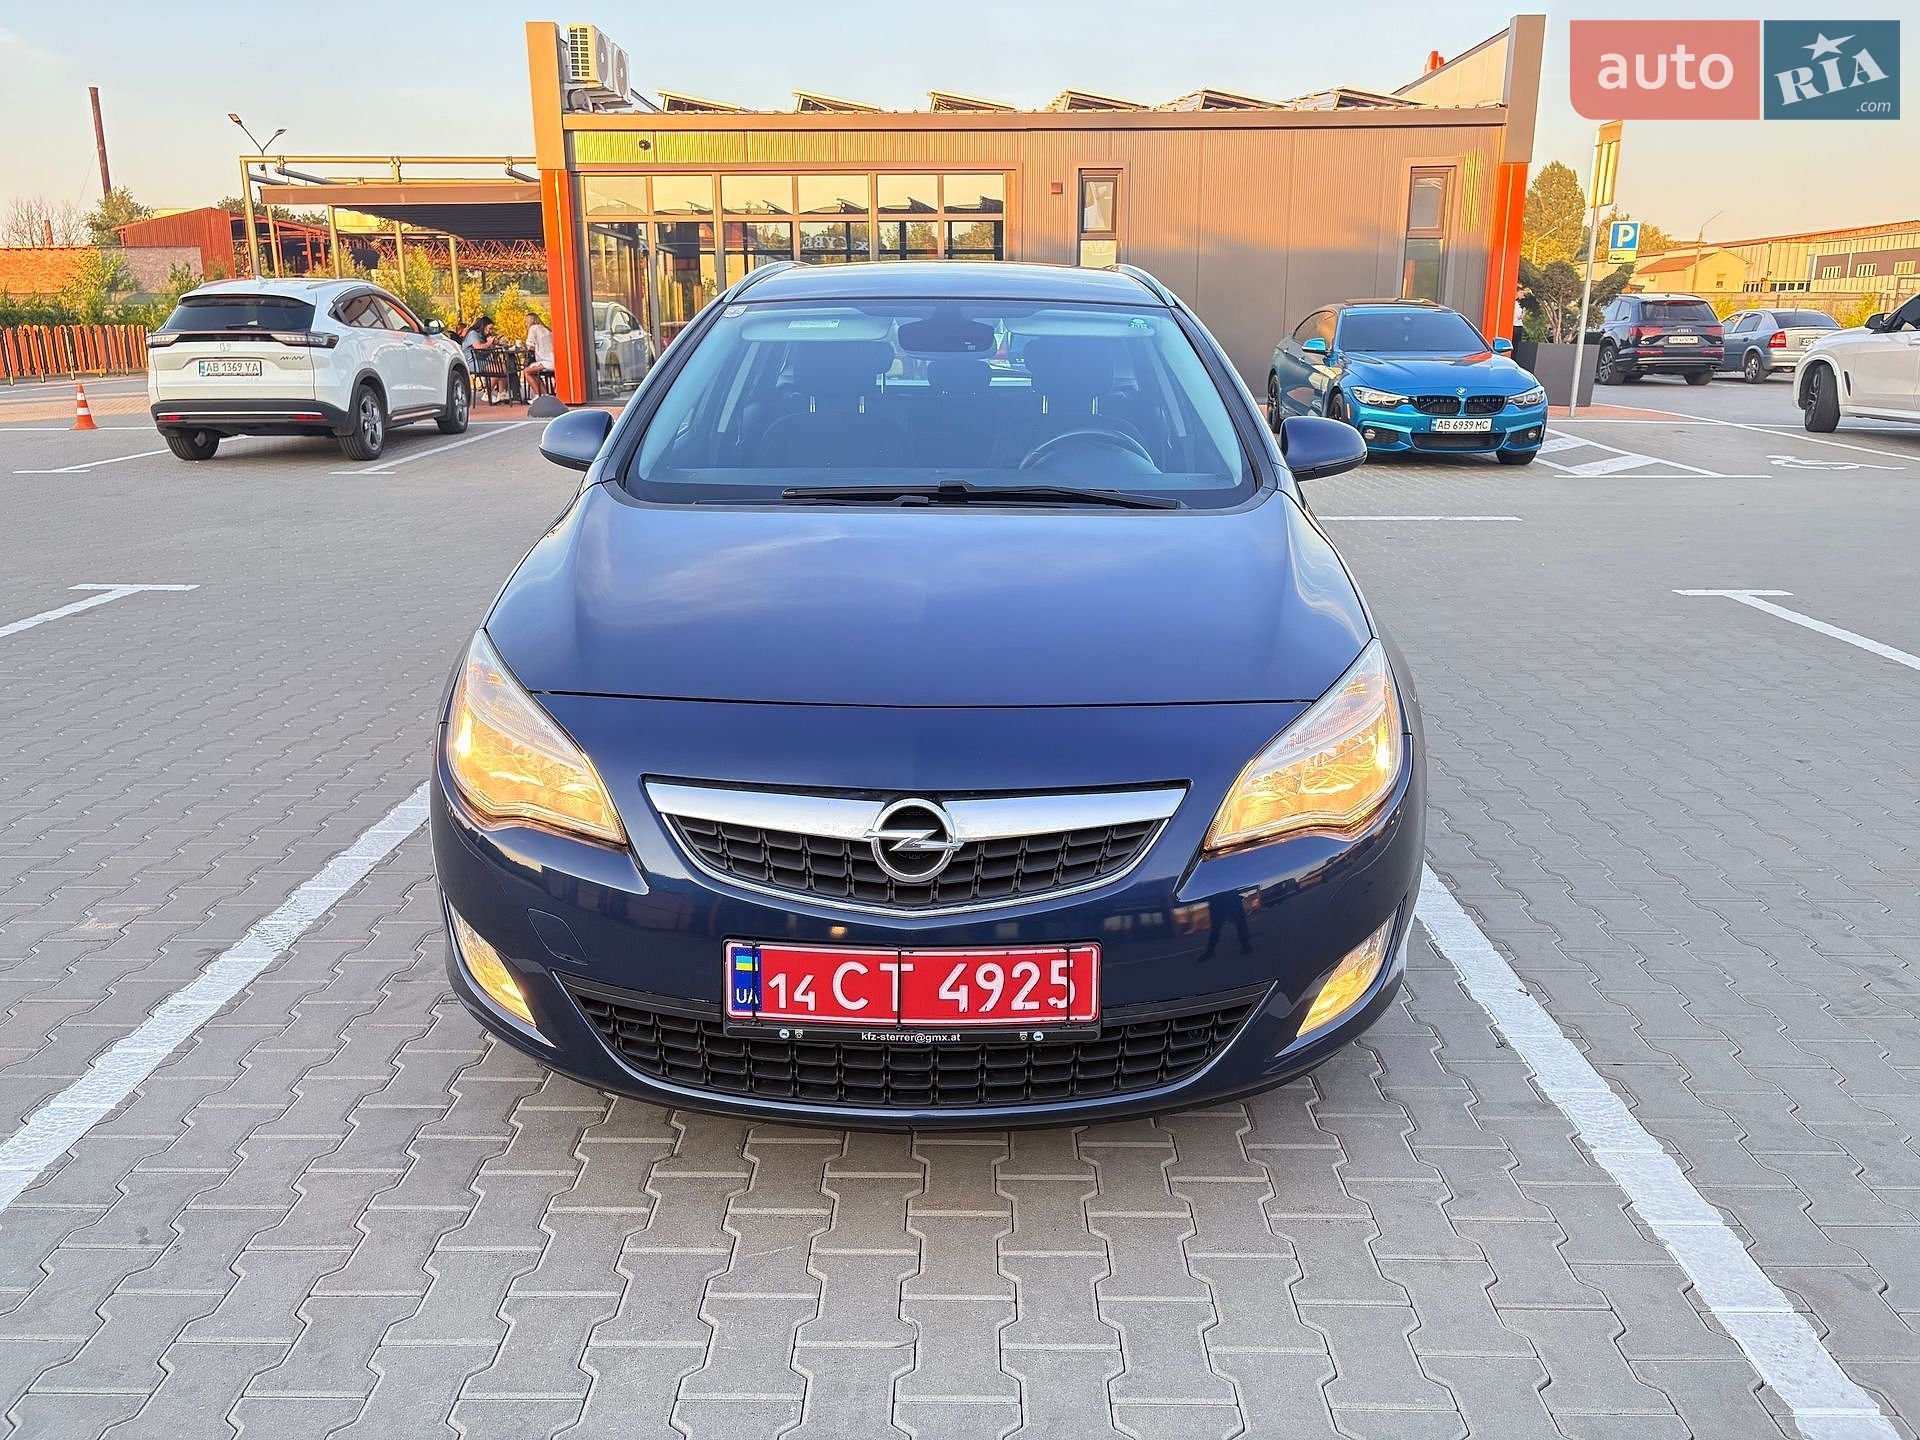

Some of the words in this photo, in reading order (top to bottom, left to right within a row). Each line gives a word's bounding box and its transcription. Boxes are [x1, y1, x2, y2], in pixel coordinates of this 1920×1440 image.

[1617, 225, 1635, 247] P
[206, 363, 219, 372] AB
[223, 363, 243, 372] 1369
[1437, 420, 1451, 430] AB
[1452, 420, 1474, 430] 6939
[1475, 420, 1489, 430] MC
[768, 973, 816, 1011] 14
[832, 961, 914, 1012] CT
[938, 959, 1076, 1012] 4925
[736, 988, 759, 1004] UA
[861, 1032, 961, 1043] kfz-sterrer@gmx.at
